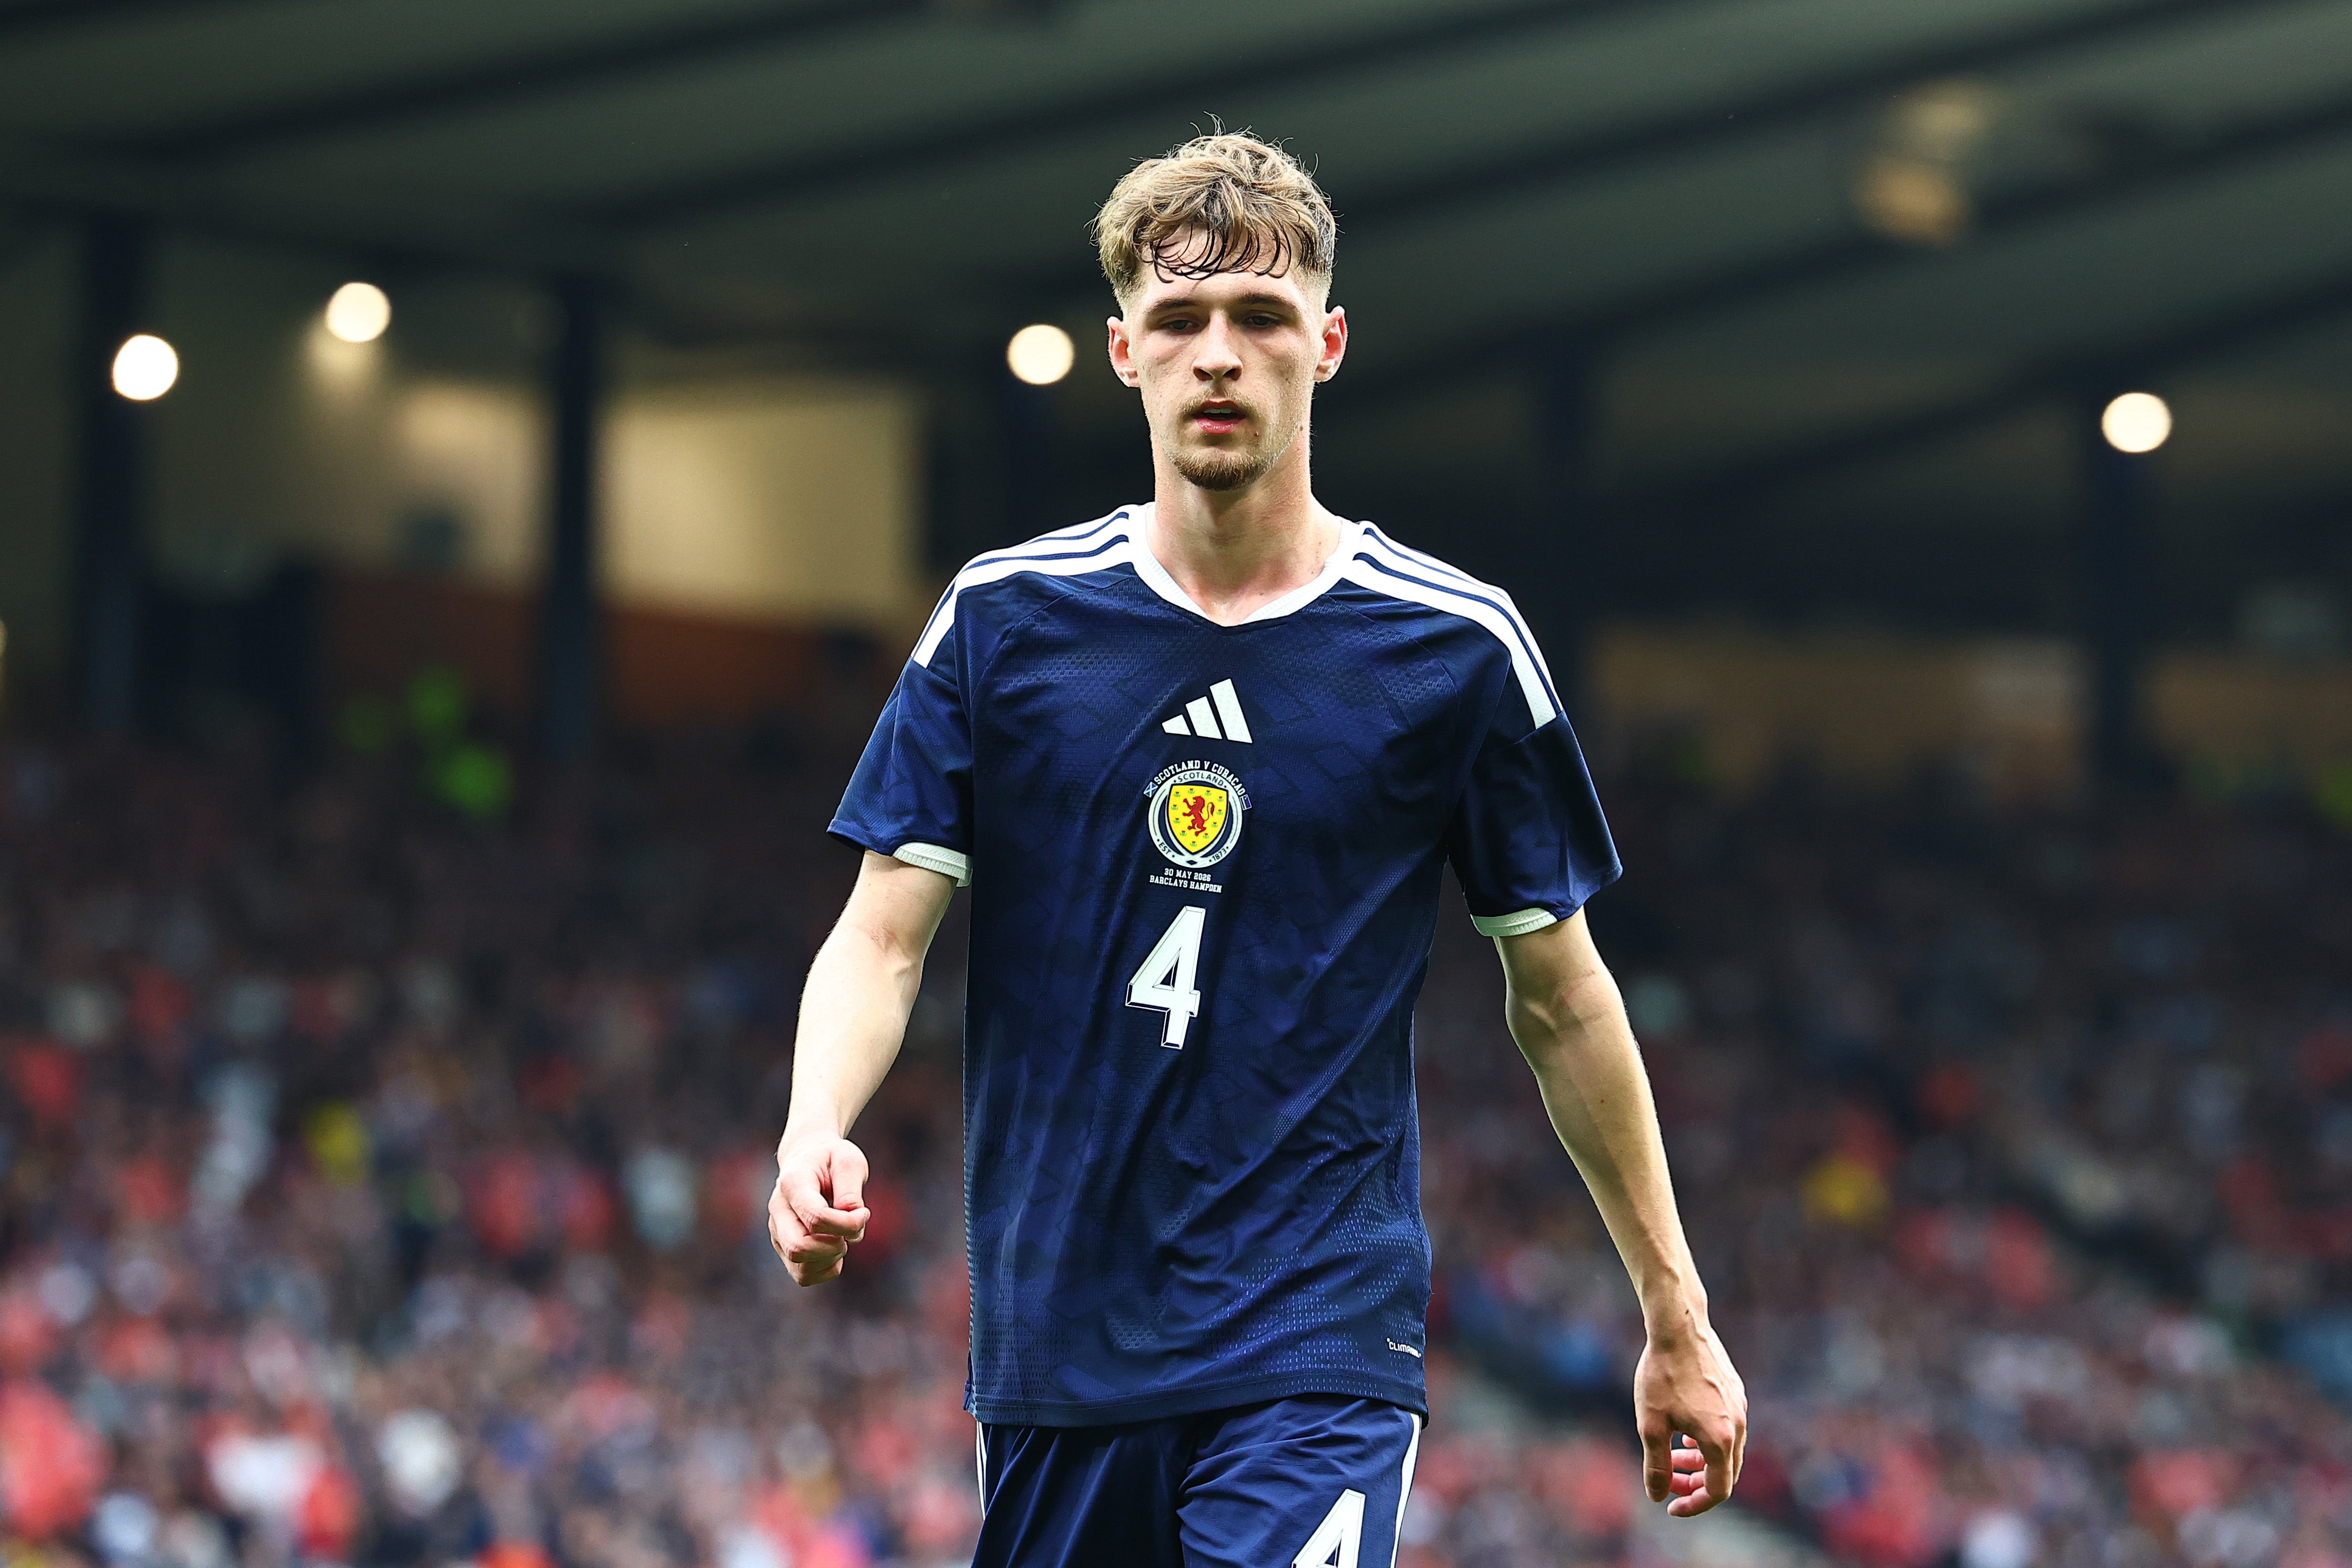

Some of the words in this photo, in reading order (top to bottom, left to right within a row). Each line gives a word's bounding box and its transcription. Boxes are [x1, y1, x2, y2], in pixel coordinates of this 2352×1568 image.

[1154, 760, 1201, 785] SCOTLAND
[1204, 761, 1210, 770] V
[1178, 772, 1224, 786] SCOTLAND
[1158, 843, 1171, 854] EST
[1212, 848, 1227, 861] 1873
[1164, 868, 1174, 876] 30
[1175, 869, 1192, 879] MAY
[1194, 872, 1211, 882] 2026
[1149, 875, 1188, 888] BARCLAYS
[1189, 881, 1222, 893] HAMPDEN
[1125, 906, 1206, 1050] 4
[1389, 1341, 1420, 1358] CLIMA
